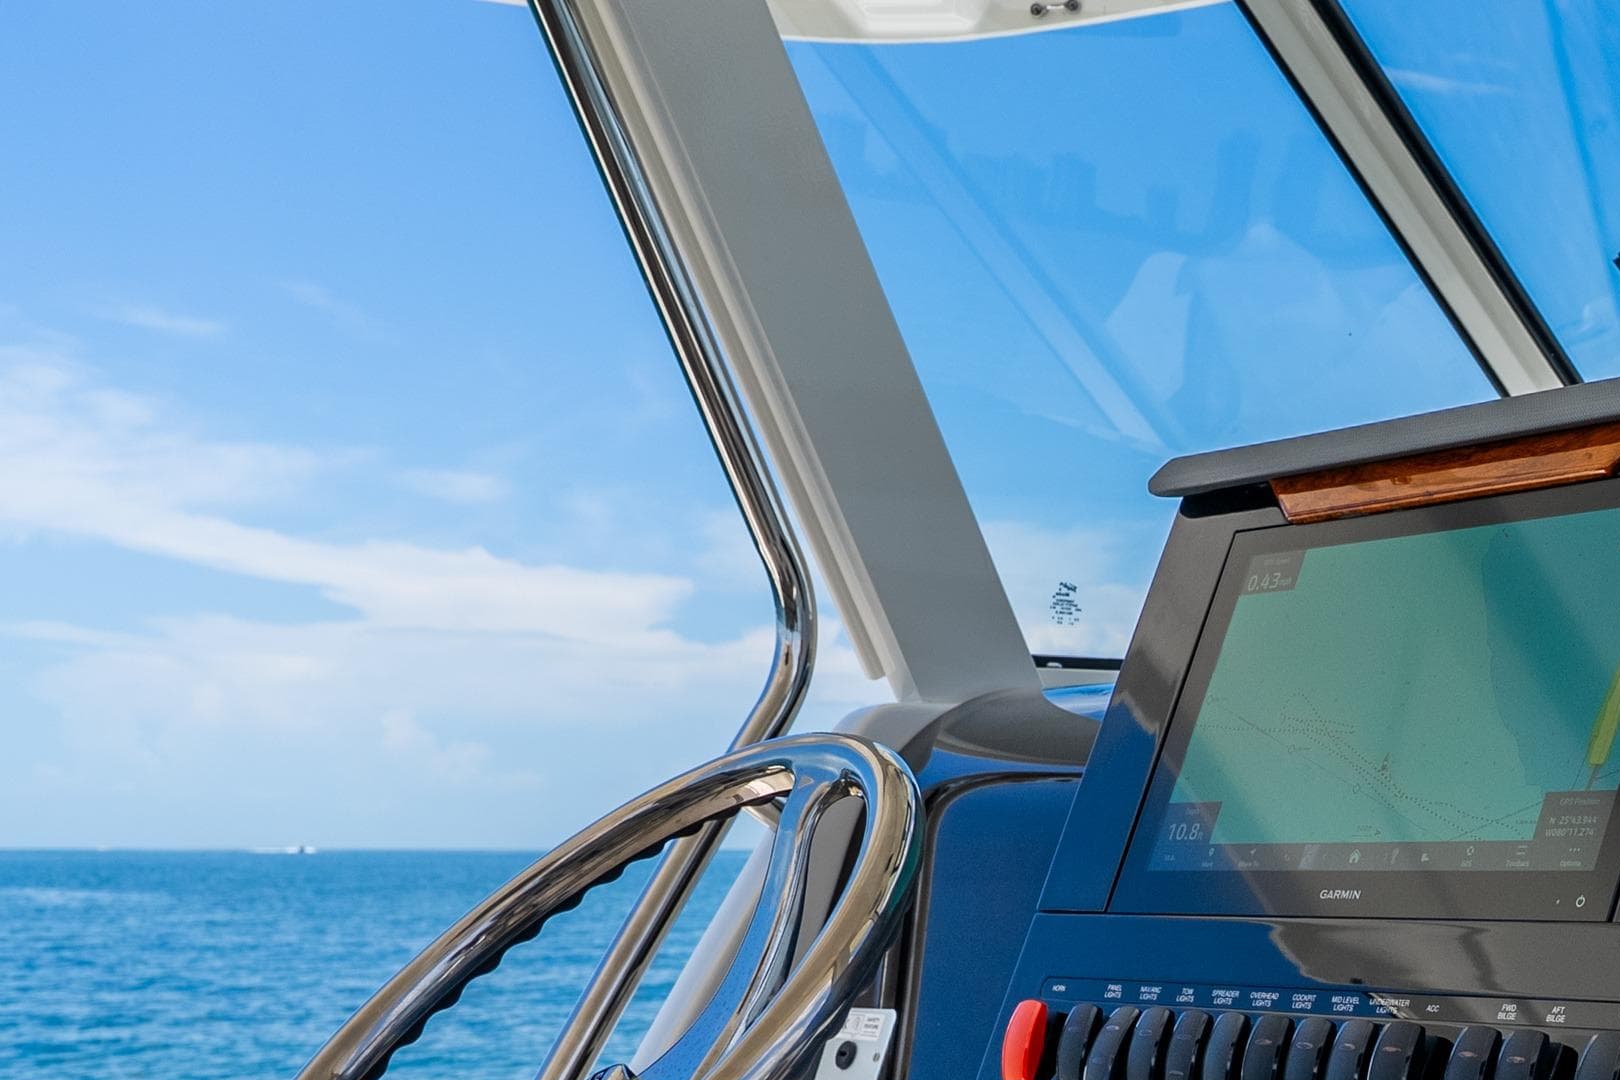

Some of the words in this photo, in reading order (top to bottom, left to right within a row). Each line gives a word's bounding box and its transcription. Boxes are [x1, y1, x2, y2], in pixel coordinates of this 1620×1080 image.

[1319, 890, 1362, 900] GARMIN
[1140, 992, 1158, 1000] LIGHTS
[1212, 990, 1240, 998] SPREADER
[1250, 992, 1280, 1000] OVERHEAD
[1292, 994, 1316, 1002] COCKPIT
[1176, 995, 1194, 1003] LIGHTS
[1214, 997, 1232, 1005] LIGHTS
[1332, 996, 1341, 1004] MID
[1342, 996, 1360, 1004] LEVEL
[1370, 998, 1410, 1008] UNDERWATER
[1252, 1000, 1272, 1008] LIGHTS
[1292, 1001, 1312, 1009] LIGHTS
[1333, 1004, 1354, 1012] LIGHTS
[1426, 1004, 1440, 1012] ACC
[1502, 1004, 1517, 1012] FWD
[1376, 1006, 1398, 1014] LIGHTS
[1552, 1006, 1566, 1014] AFT
[1498, 1012, 1516, 1020] BILGE
[1546, 1014, 1566, 1023] BILGE
